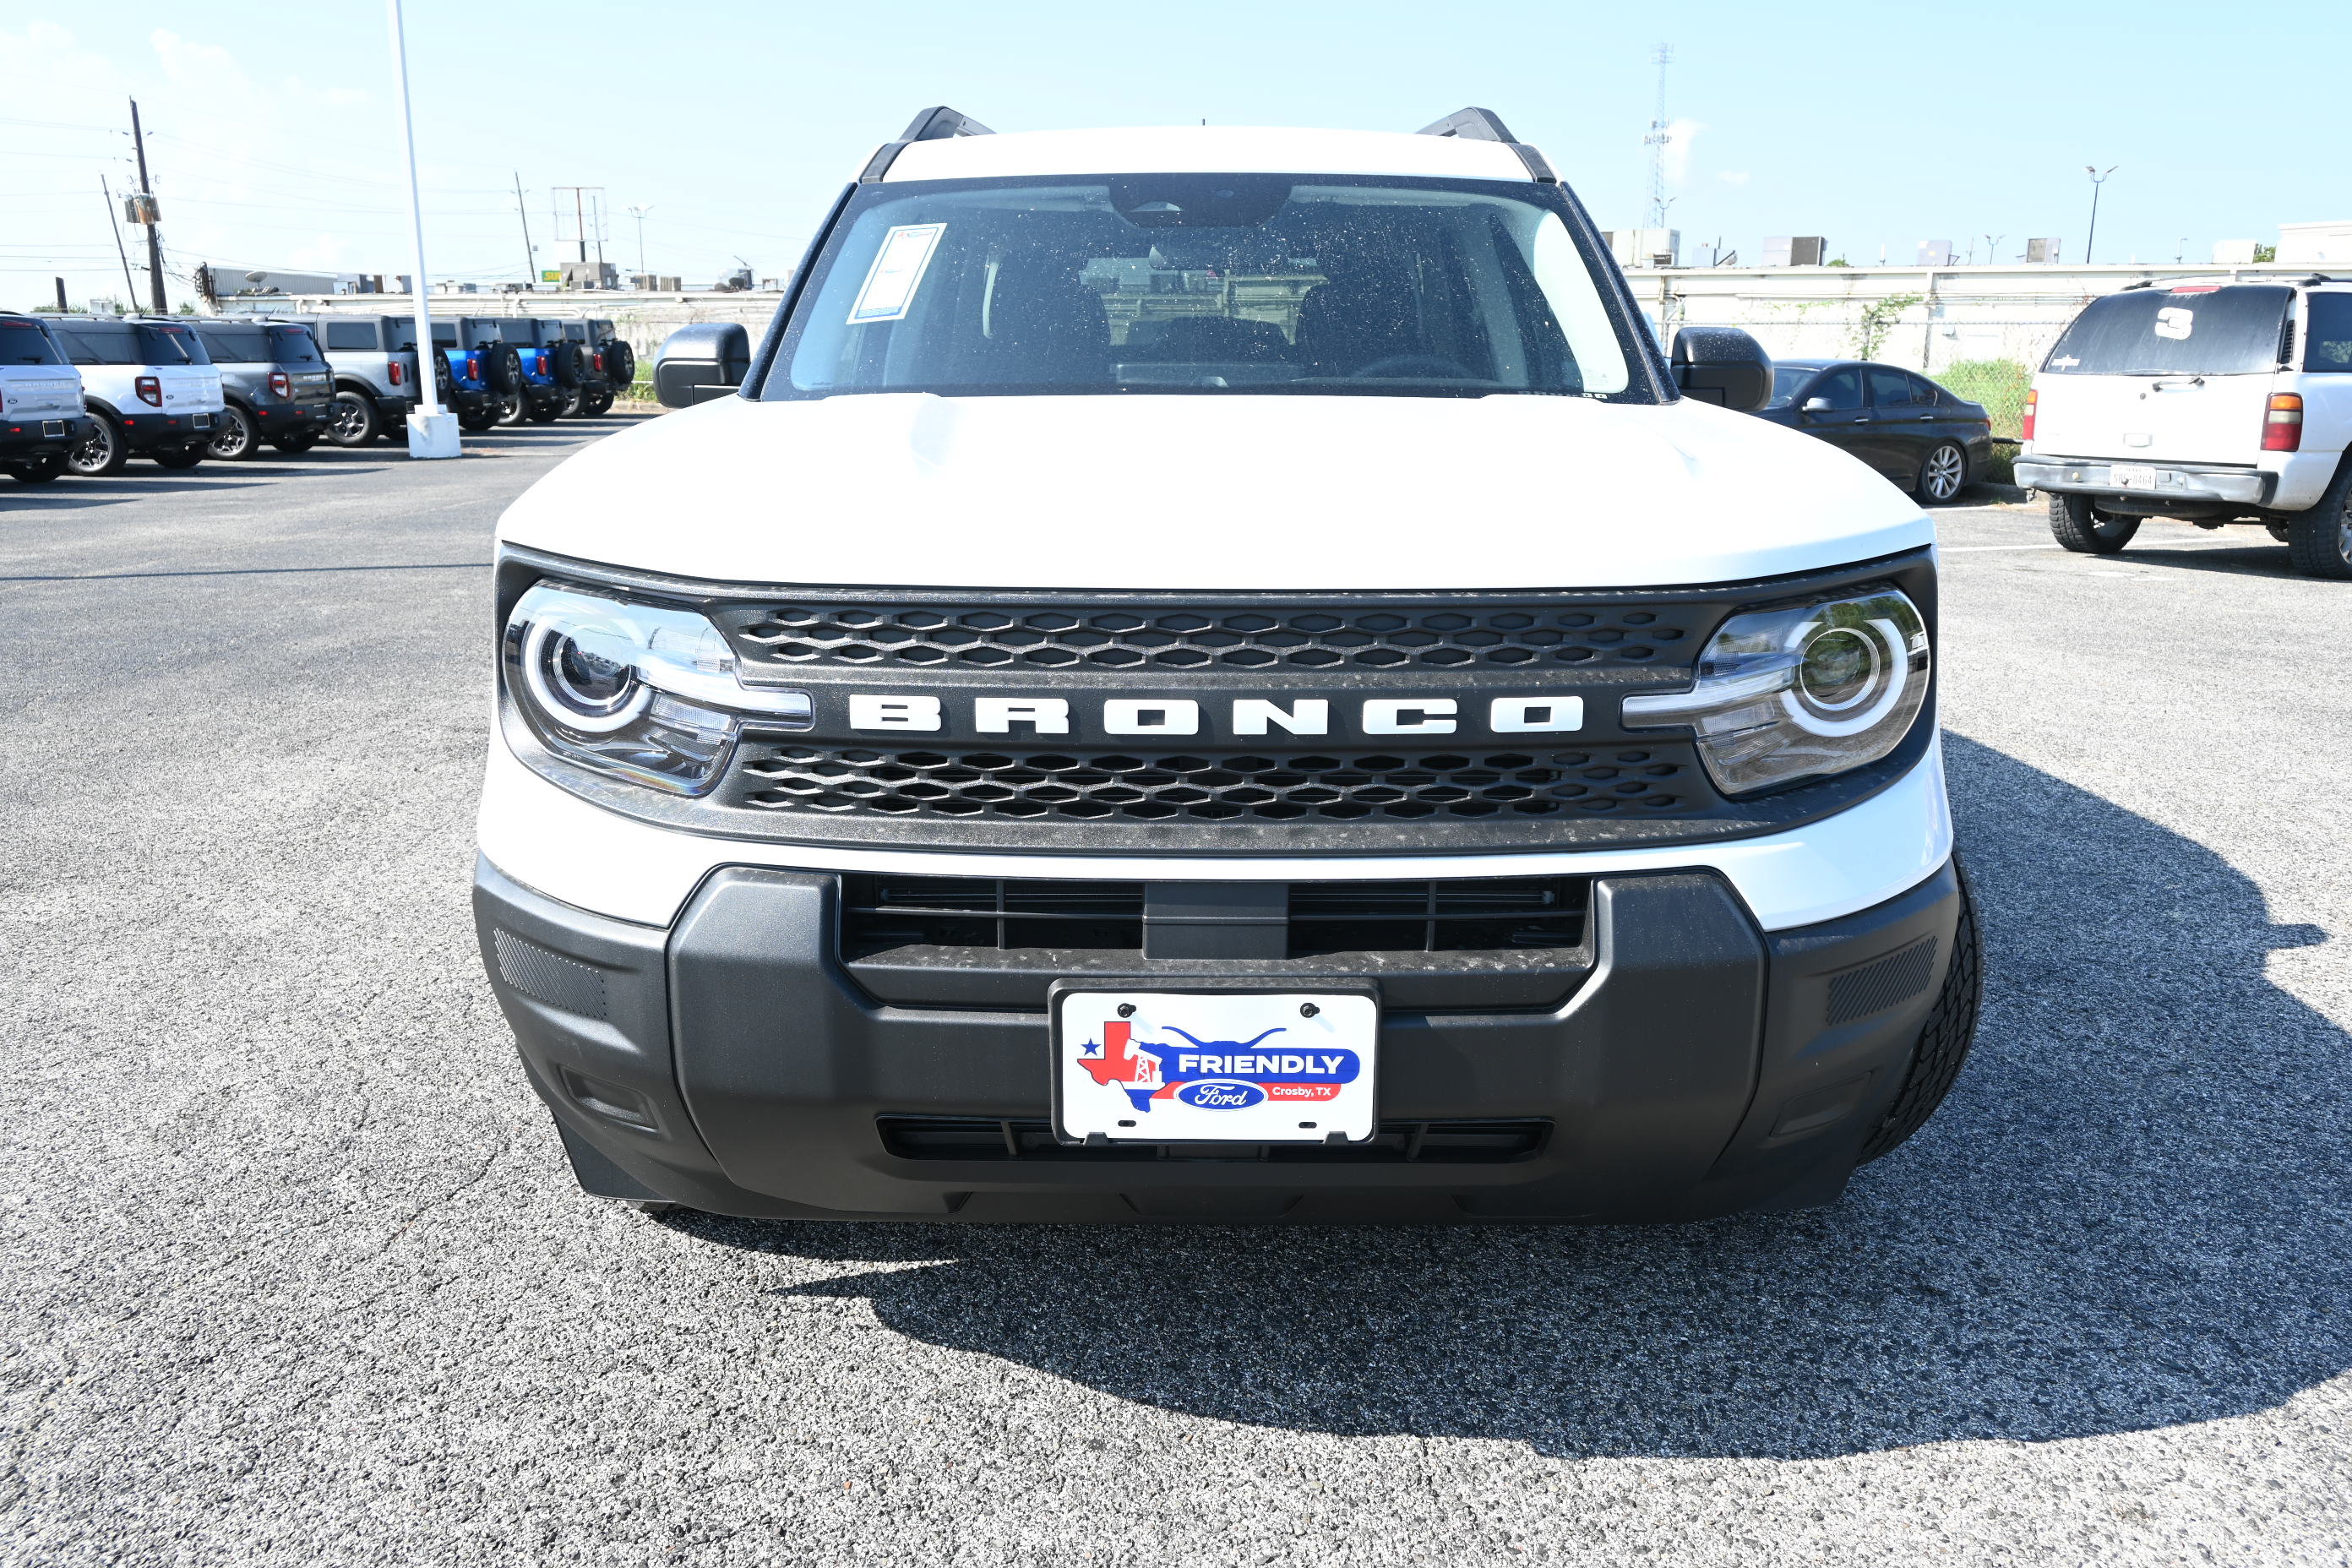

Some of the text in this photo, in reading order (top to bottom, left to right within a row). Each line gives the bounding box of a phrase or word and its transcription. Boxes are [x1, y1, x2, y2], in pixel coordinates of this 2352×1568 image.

[2155, 307, 2193, 340] 3
[849, 694, 1584, 735] BRONCO
[1179, 1054, 1345, 1075] FRIENDLY
[1194, 1084, 1248, 1106] Ford
[1272, 1086, 1331, 1097] Crosby, TX
